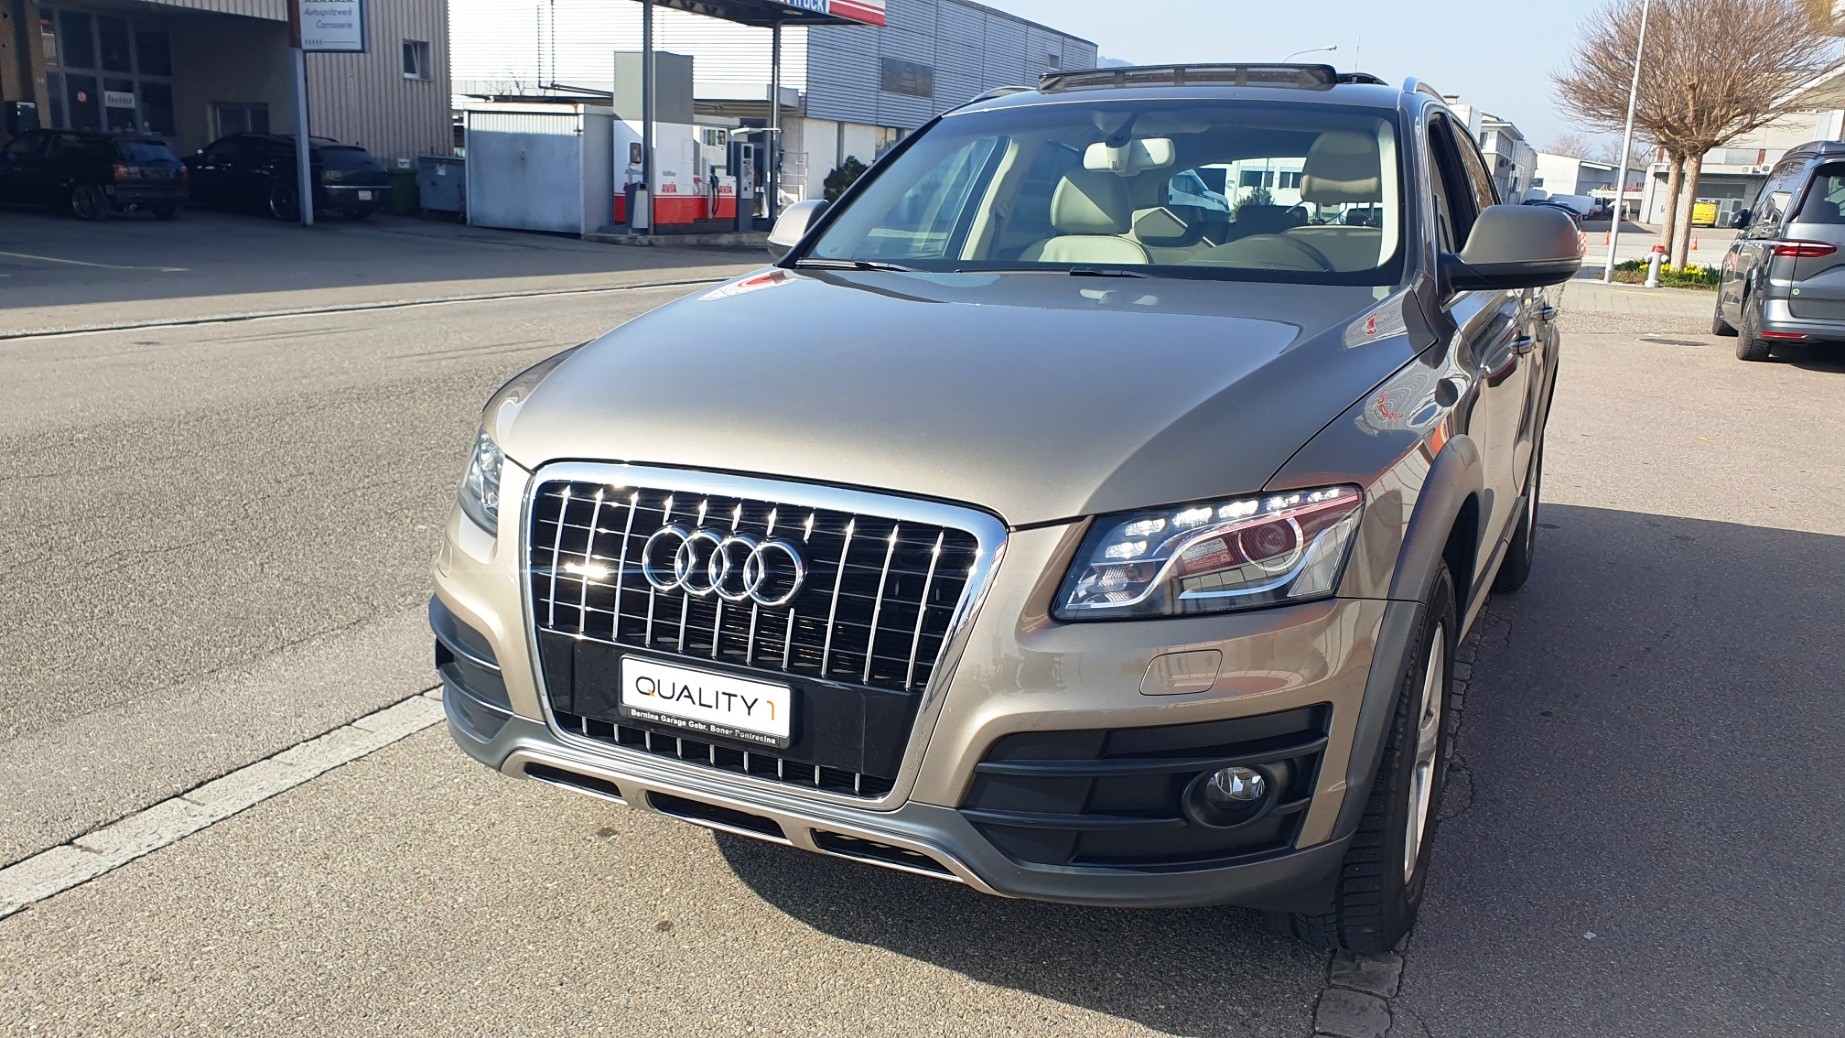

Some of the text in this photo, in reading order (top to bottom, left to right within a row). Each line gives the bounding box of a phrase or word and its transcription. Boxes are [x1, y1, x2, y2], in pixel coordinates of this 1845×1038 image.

[661, 182, 678, 194] AVIA
[635, 676, 775, 720] QUALITY 1
[631, 709, 659, 721] Bernina
[660, 714, 686, 728] Garage
